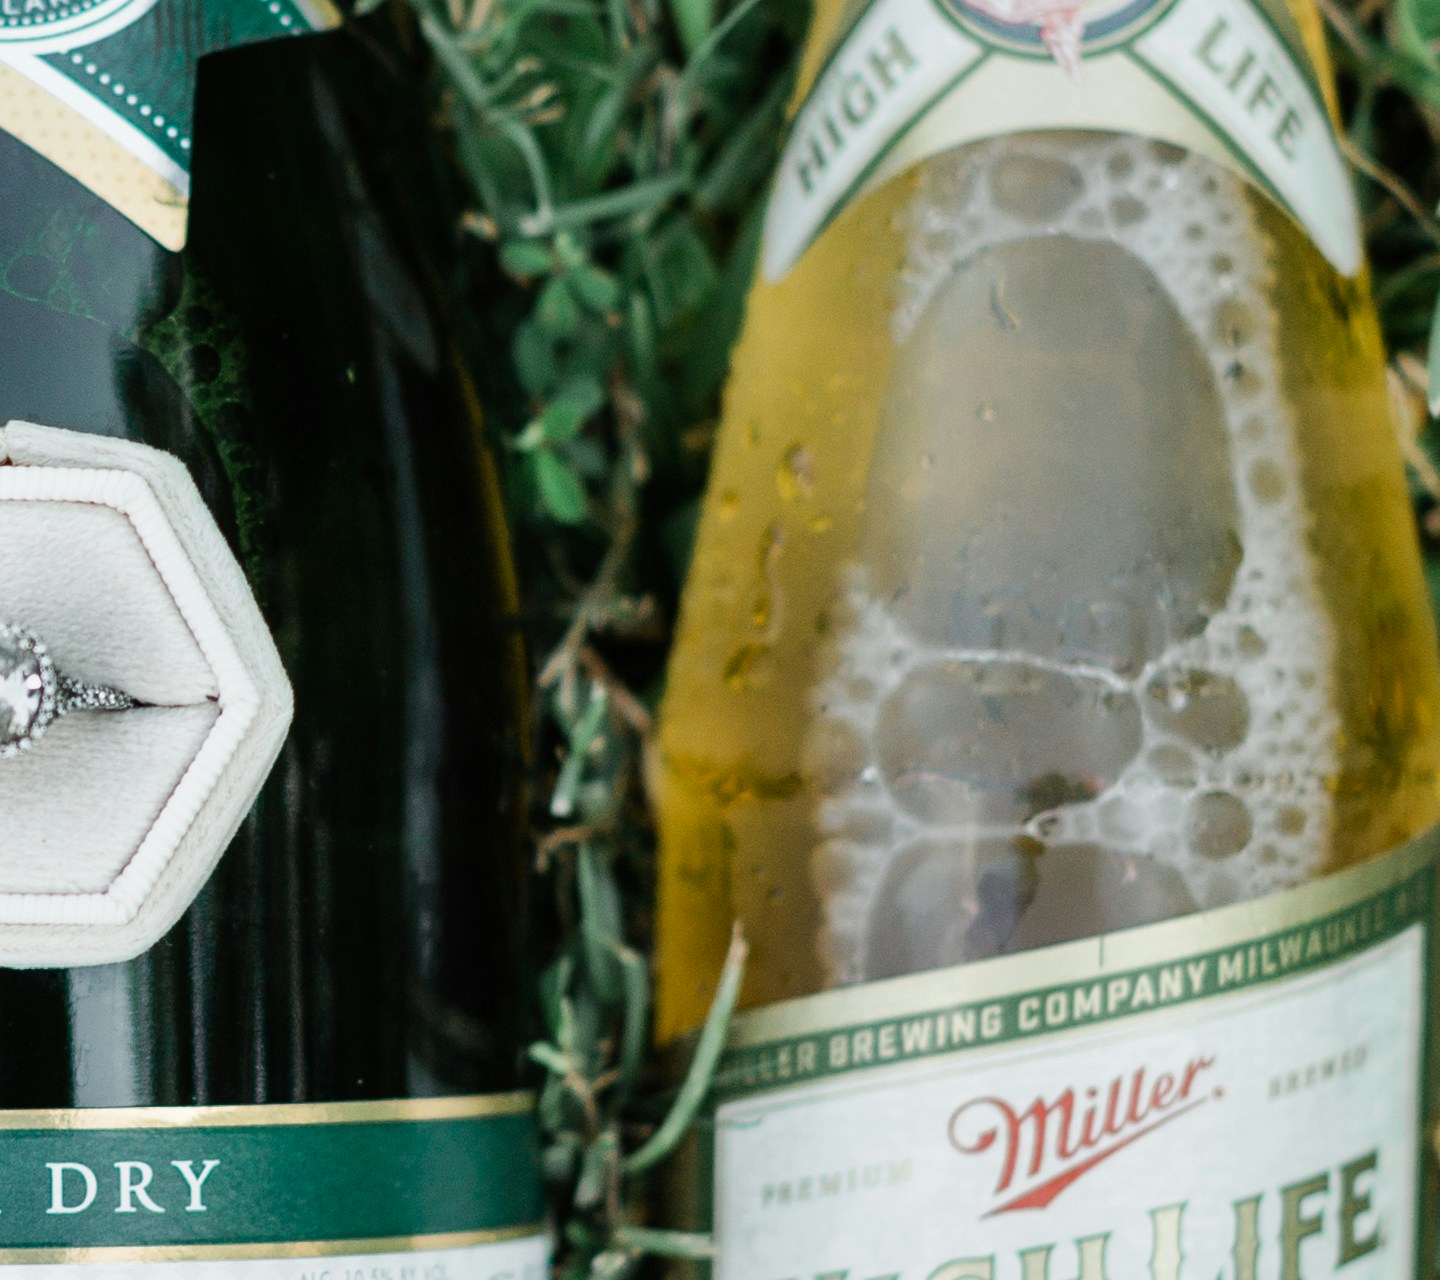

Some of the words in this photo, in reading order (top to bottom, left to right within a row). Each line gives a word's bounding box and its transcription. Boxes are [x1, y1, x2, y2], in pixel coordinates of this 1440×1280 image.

[793, 25, 918, 196] HIGH
[1192, 18, 1310, 163] LIFE
[829, 1004, 1002, 1069] BREWING
[1018, 961, 1208, 1033] COMPANY
[45, 1157, 224, 1215] DRY
[948, 1052, 1217, 1198] Miller
